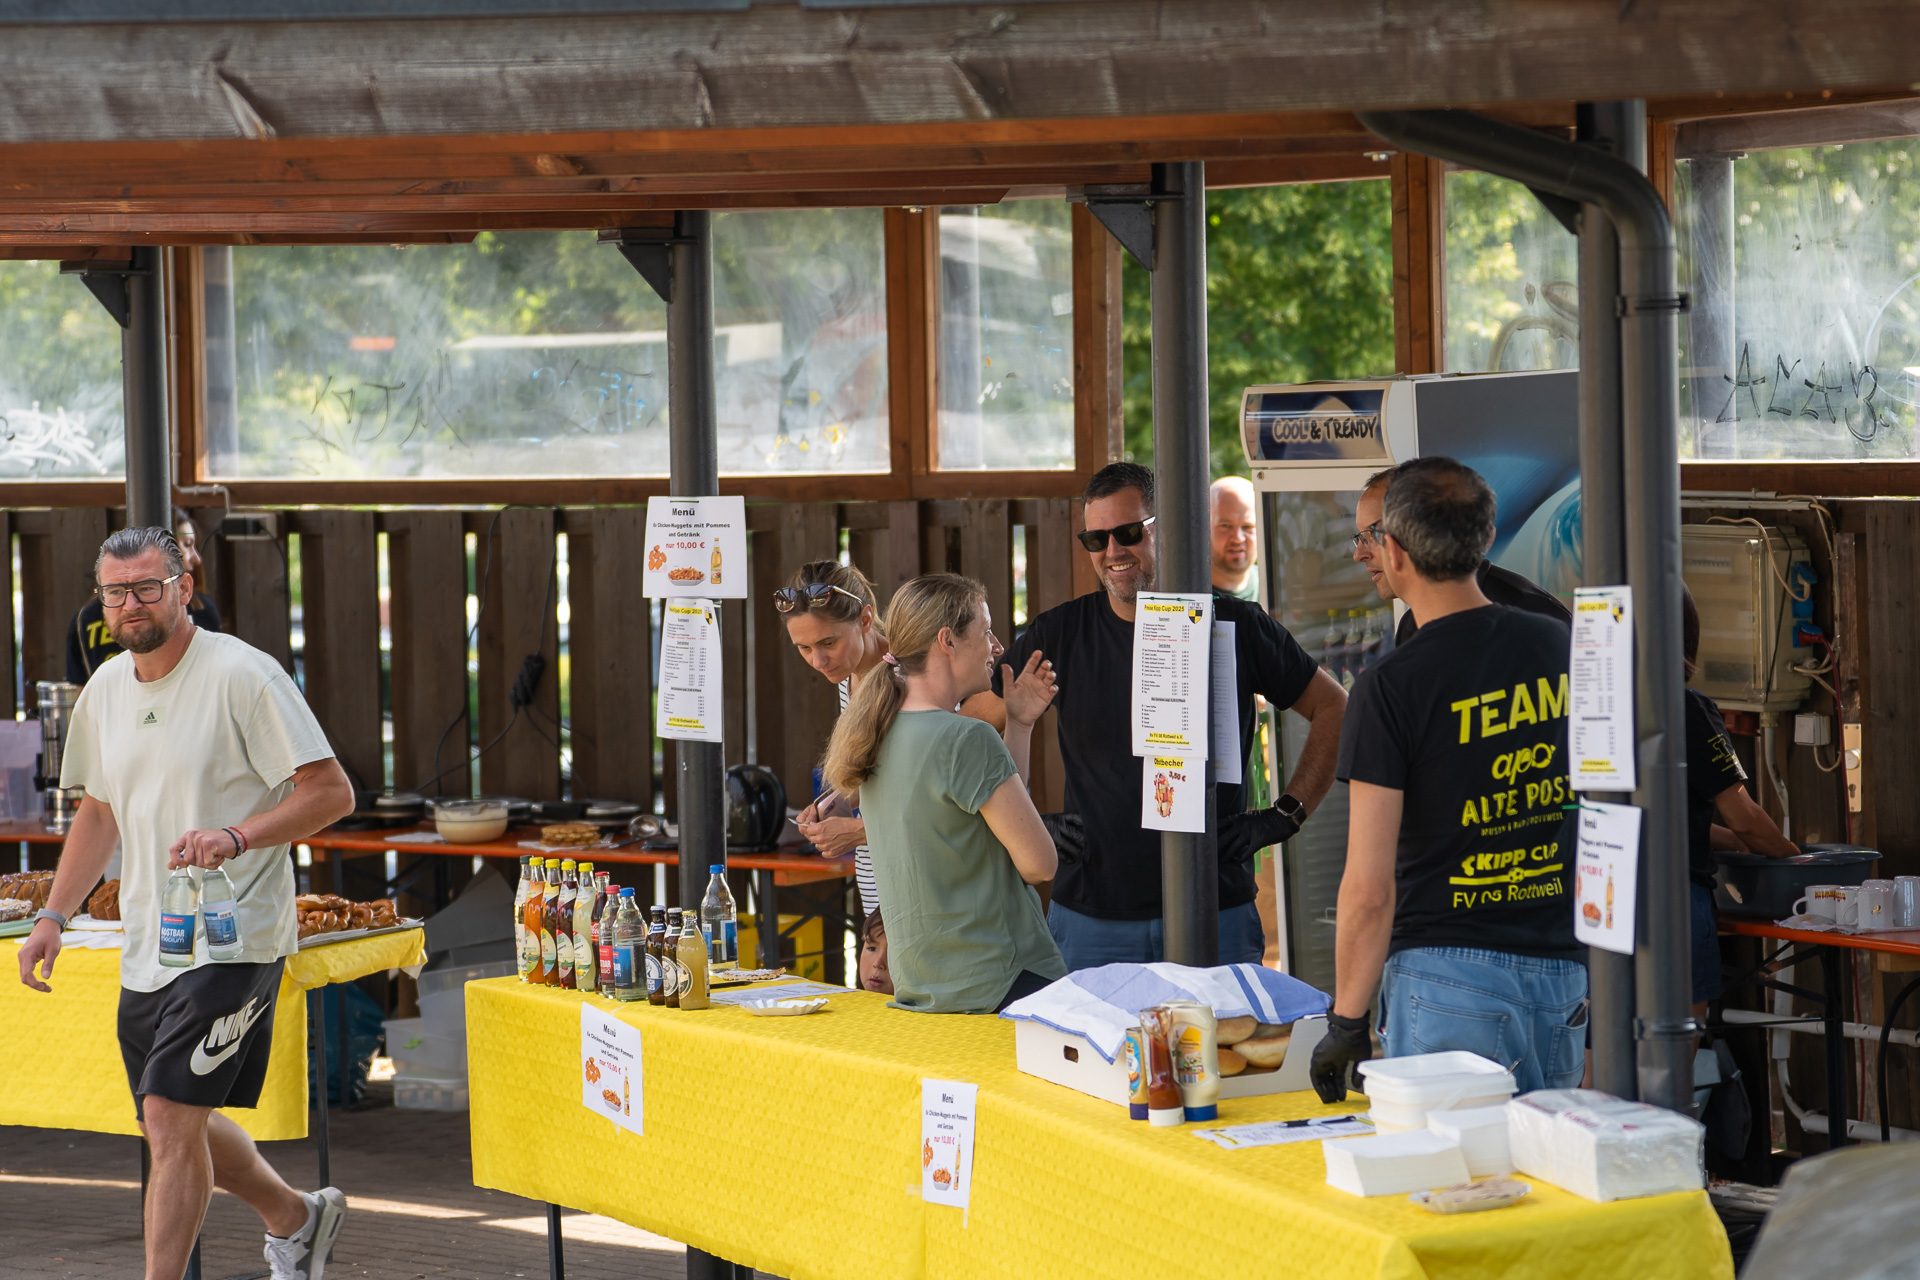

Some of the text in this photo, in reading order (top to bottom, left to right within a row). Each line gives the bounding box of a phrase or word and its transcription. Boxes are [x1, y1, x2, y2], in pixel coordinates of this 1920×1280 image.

[1273, 416, 1377, 441] COOL & TRENDY
[672, 507, 695, 516] Menü
[676, 541, 697, 550] 10,00
[700, 541, 705, 549] €
[1450, 673, 1569, 744] TEAM
[1461, 788, 1518, 827] ALTE
[1530, 841, 1559, 861] CUP
[1452, 891, 1477, 909] FV
[1507, 877, 1563, 902] Rottweil
[206, 996, 258, 1049] NIKE
[603, 1023, 617, 1038] Menü
[942, 1093, 954, 1103] Menü
